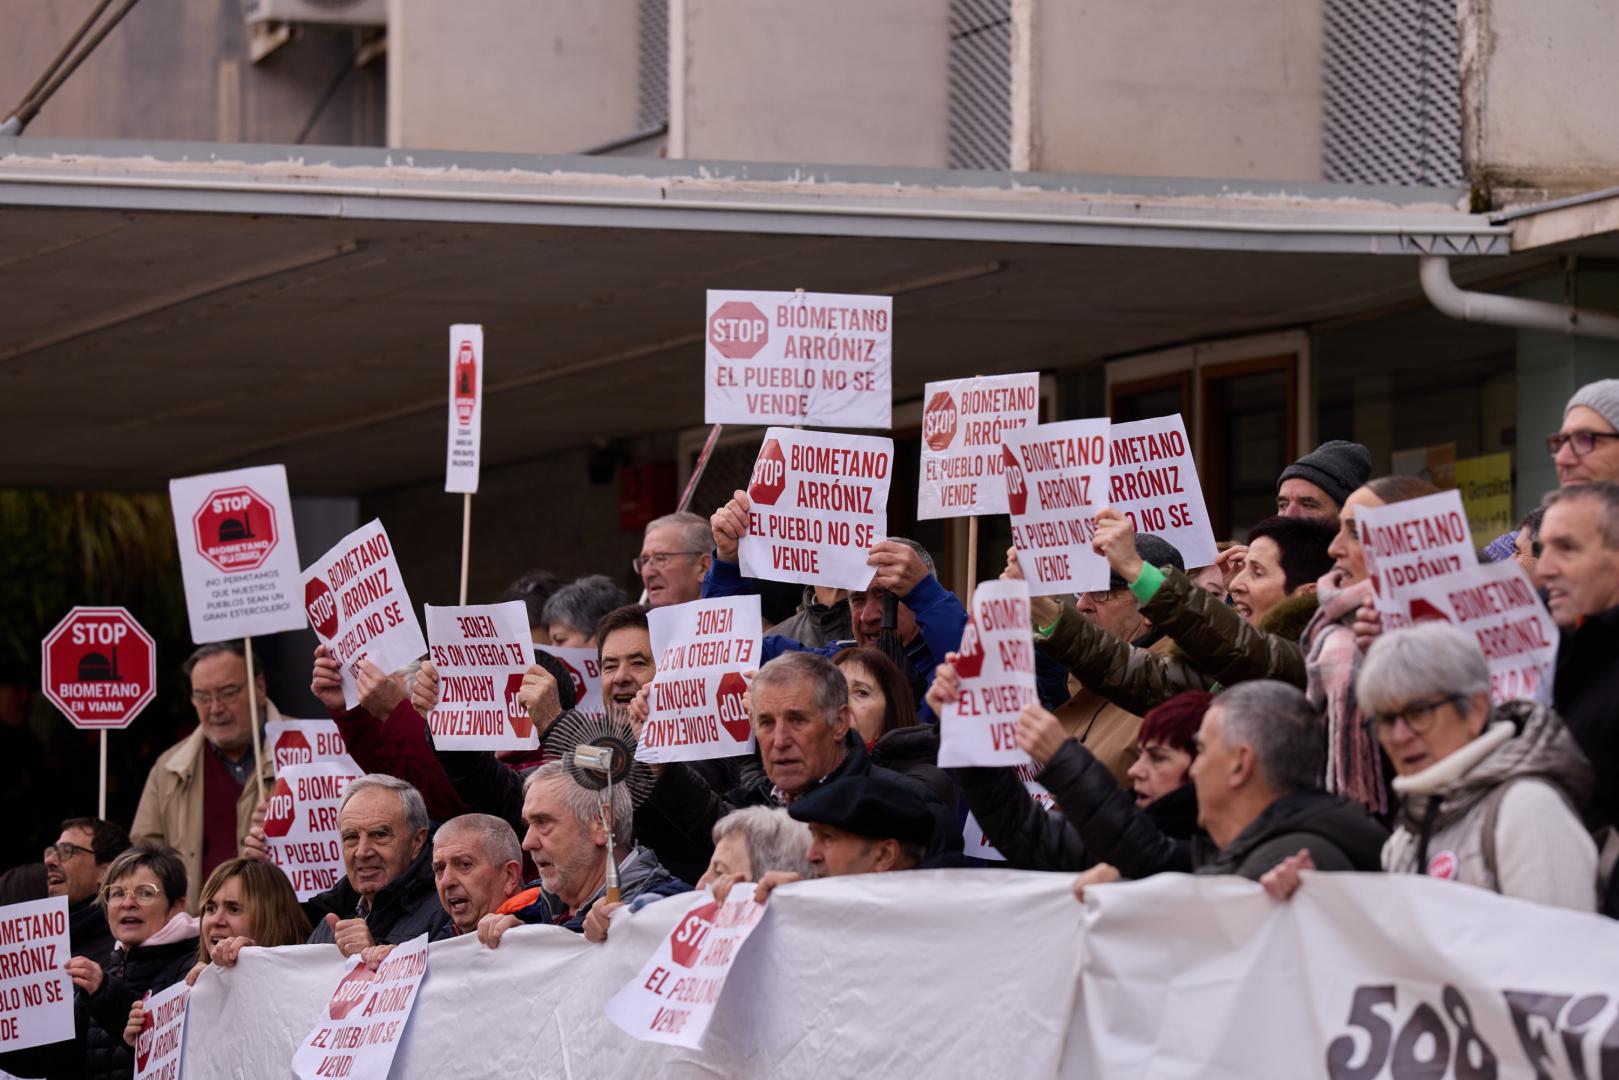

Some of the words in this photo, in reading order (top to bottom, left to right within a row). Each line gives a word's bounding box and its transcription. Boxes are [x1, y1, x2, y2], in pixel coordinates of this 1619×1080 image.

[713, 318, 765, 343] STOP
[777, 305, 888, 332] BIOMETANO
[784, 333, 876, 362] ARRÓNIZ
[717, 367, 738, 387] EL
[744, 367, 815, 389] PUEBLO
[822, 369, 847, 390] NO
[853, 371, 876, 392] SE
[746, 393, 809, 417] VENDE
[961, 386, 1035, 415] BIOMETANO
[926, 409, 956, 436] STOP
[791, 444, 888, 480] BIOMETANO
[926, 460, 938, 481] EL
[940, 455, 983, 480] PUEBLO
[987, 454, 1005, 476] NO
[1020, 435, 1105, 473] BIOMETANO
[797, 479, 873, 514] ARRÓNIZ
[941, 483, 978, 507] VENDE
[1037, 473, 1092, 511] ARRÓNIZ
[1109, 465, 1184, 503] RRÓNIZ
[212, 495, 251, 514] STOP
[1141, 507, 1166, 533] NO
[1168, 503, 1193, 528] SE
[749, 512, 766, 537] EL
[769, 514, 823, 544] PUEBLO
[828, 521, 850, 547] NO
[855, 524, 874, 548] SE
[1012, 526, 1028, 551] EL
[1026, 521, 1069, 550] PUEBLO
[1068, 519, 1086, 545] NO
[327, 533, 390, 592] BIOMETANO
[772, 545, 819, 574] VENDE
[1034, 554, 1072, 583] VENDE
[212, 588, 229, 599] QUE
[246, 594, 270, 605] SEAN
[271, 592, 284, 602] UN
[341, 567, 393, 622] ARRÓNIZ
[1448, 576, 1535, 623] BIOMETANO
[203, 610, 228, 622] GRAN
[309, 591, 335, 628] STOP
[696, 608, 733, 635] VENDE
[72, 622, 127, 645] STOP
[337, 624, 367, 663] PUEBLO
[365, 612, 385, 640] NO
[385, 601, 404, 628] SE
[457, 616, 498, 638] VENDE
[431, 646, 449, 667] SE
[448, 645, 467, 666] NO
[465, 644, 509, 666] PUEBLO
[506, 643, 525, 665] EL
[671, 643, 684, 669] NO
[688, 639, 732, 668] PUEBLO
[735, 639, 753, 663] EL
[60, 683, 140, 698] BIOMETANO
[441, 675, 495, 707] ARRÓNIZ
[654, 678, 707, 715] ARRÓNIZ
[957, 689, 981, 716] EL
[71, 701, 84, 712] EN
[88, 701, 125, 712] VIANA
[721, 693, 750, 722] TOP
[430, 710, 504, 736] BIOMETANO
[645, 714, 719, 747] BIOMETANO
[285, 840, 340, 864] PUEBLO
[292, 868, 338, 891] VENDE
[0, 944, 58, 980] RRÓNIZ
[22, 983, 42, 1008] NO
[44, 980, 64, 1003] SE
[644, 966, 671, 996] EL
[310, 1028, 332, 1049] EL
[368, 1022, 384, 1045] NO
[383, 1021, 400, 1043] SE
